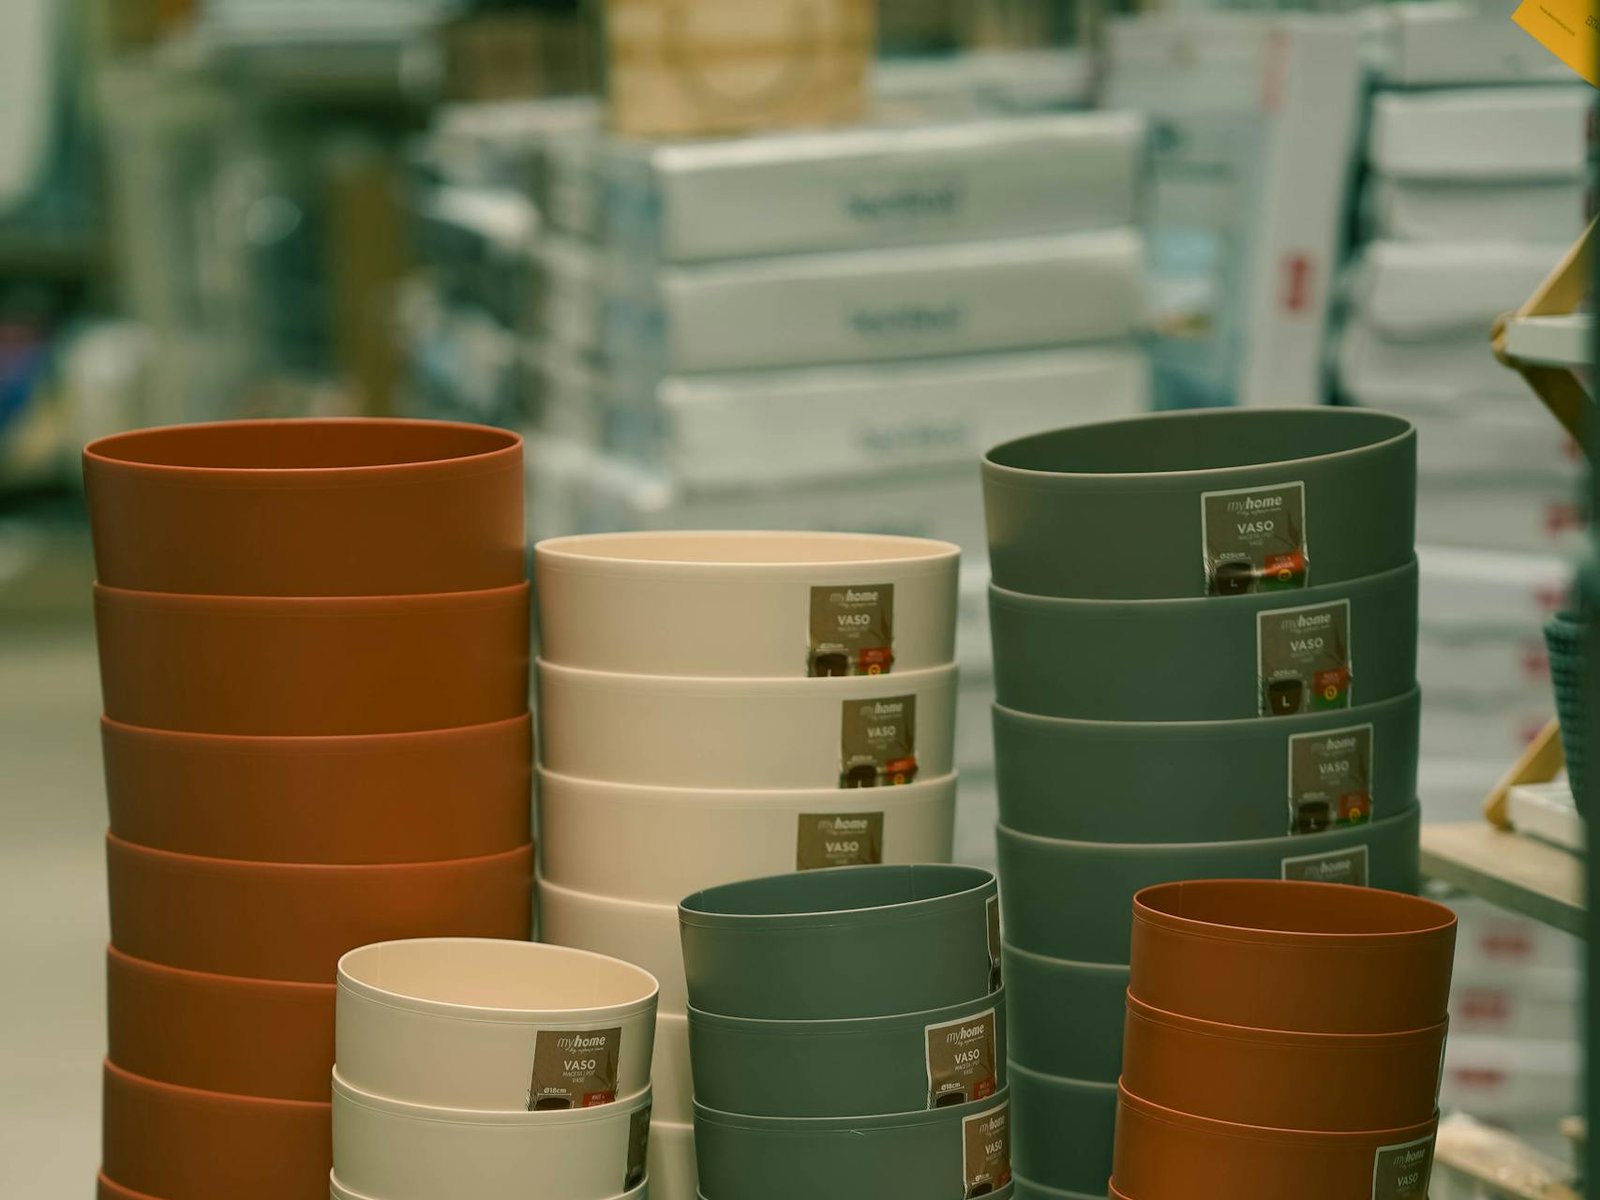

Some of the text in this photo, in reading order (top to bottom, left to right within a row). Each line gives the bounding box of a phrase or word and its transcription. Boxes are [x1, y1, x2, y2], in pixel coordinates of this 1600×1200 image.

[1227, 496, 1283, 513] myhome
[1237, 520, 1274, 534] VASO
[837, 614, 870, 626] VASO
[1290, 637, 1323, 652] VASO
[1282, 695, 1290, 707] L
[867, 725, 896, 738] VASO
[1319, 760, 1349, 774] VASO
[825, 841, 860, 852] VASO
[947, 1024, 984, 1045] myhome
[557, 1035, 606, 1051] myhome
[954, 1048, 980, 1064] VASO
[564, 1059, 596, 1071] VASO
[985, 1140, 1002, 1154] VASO
[1397, 1172, 1419, 1187] VASO
